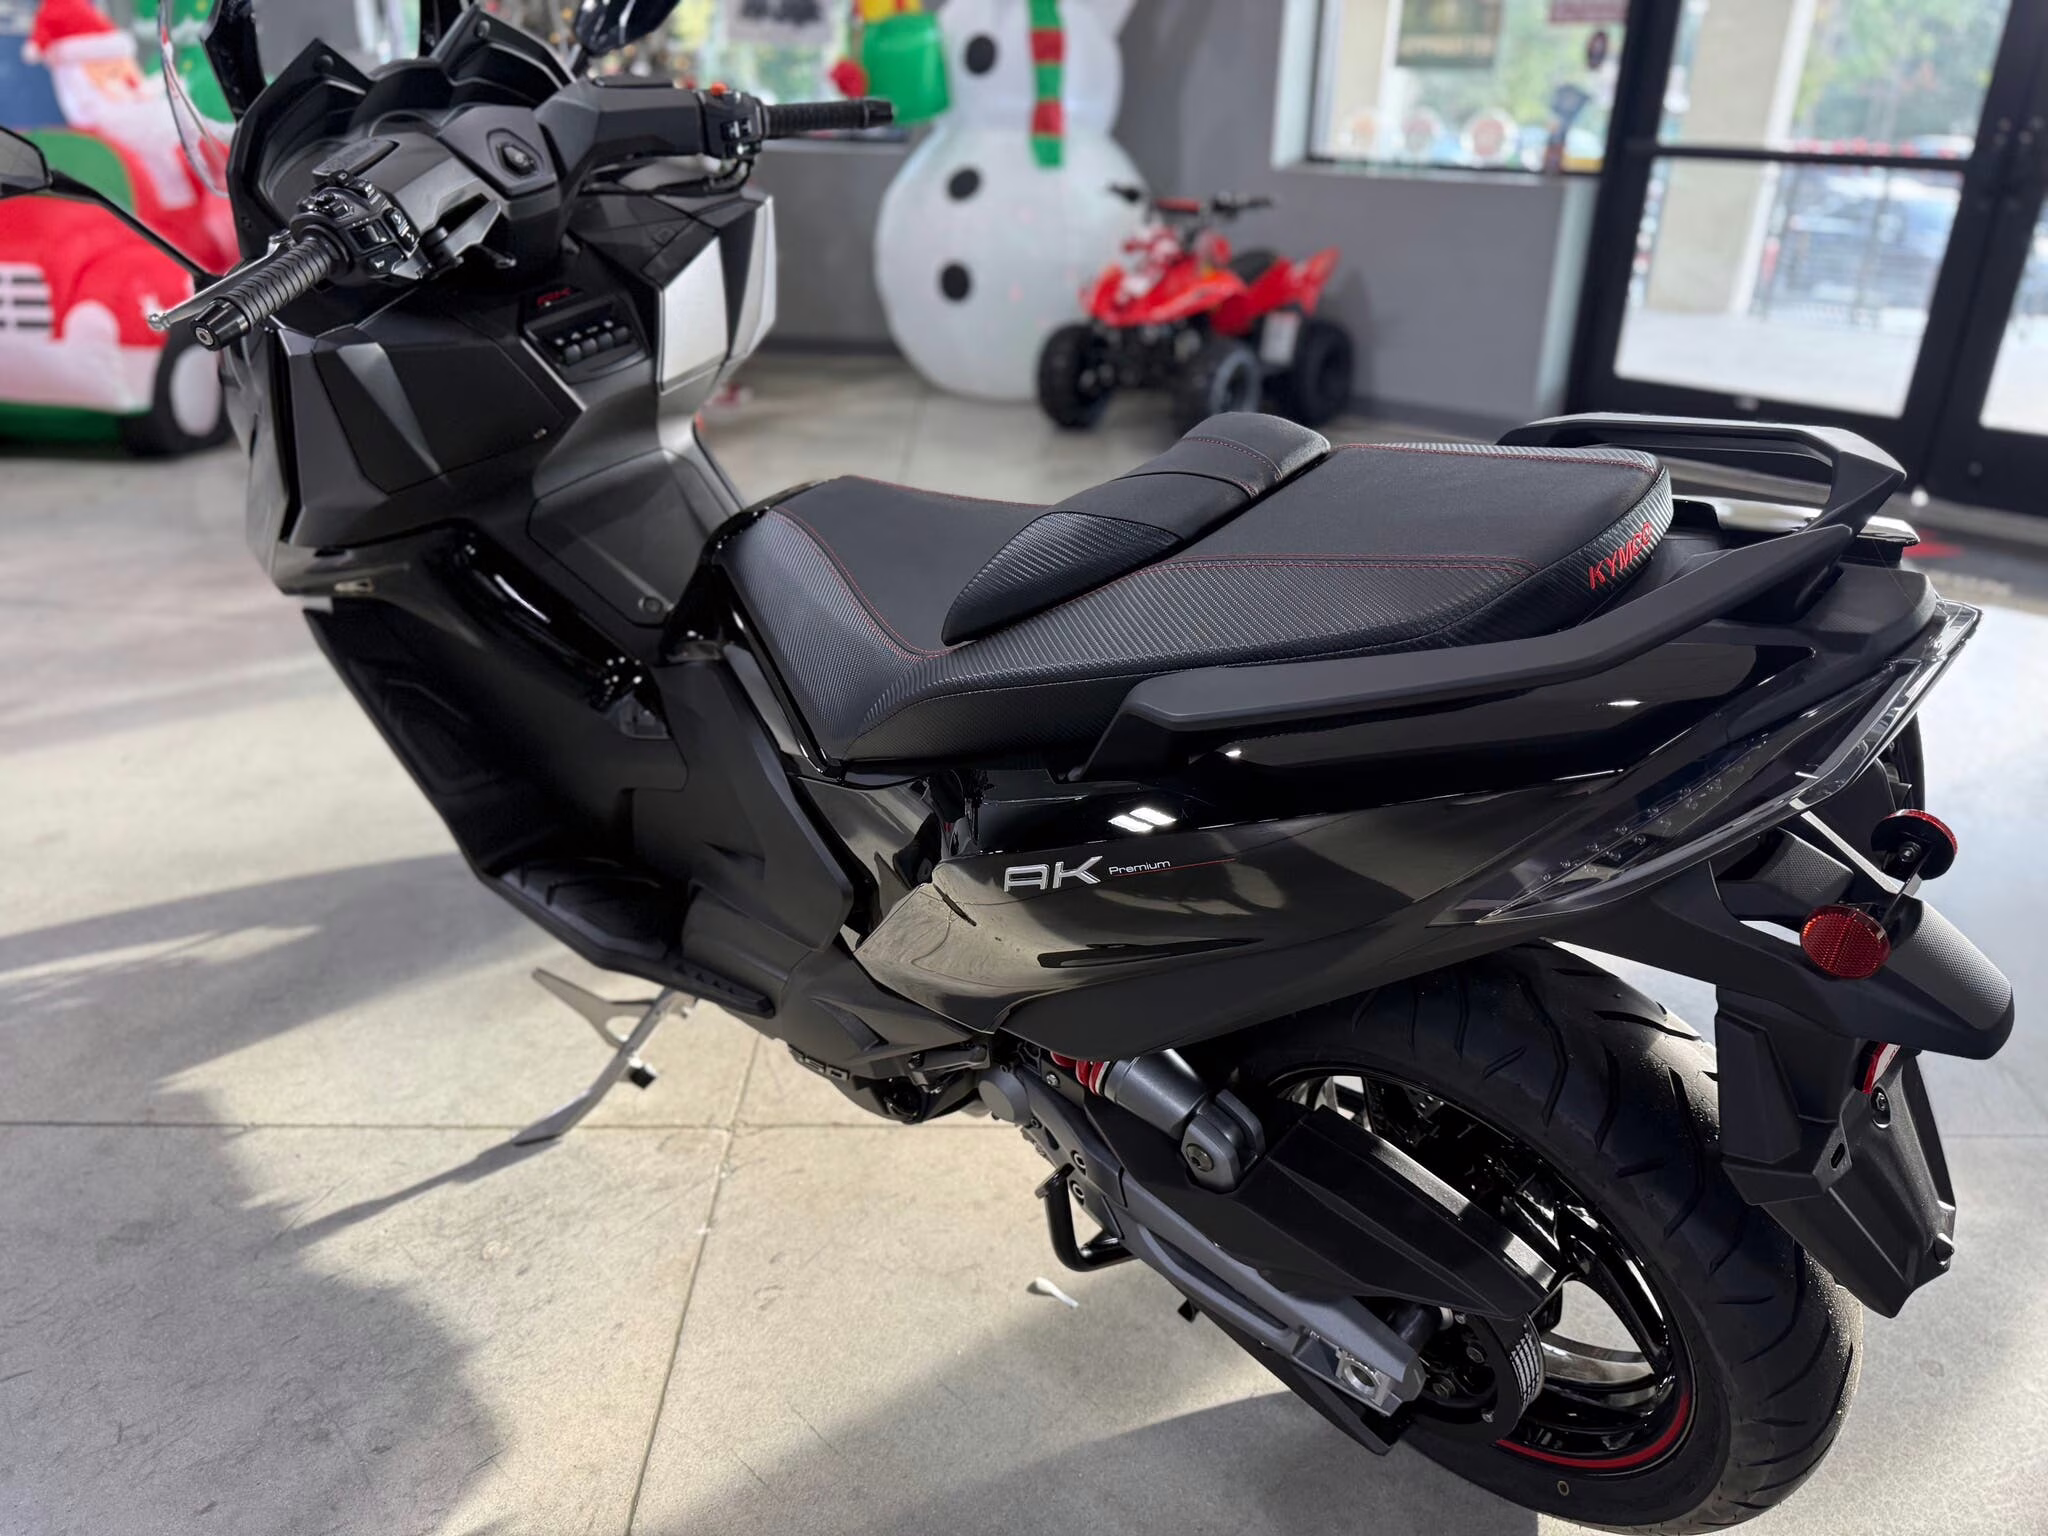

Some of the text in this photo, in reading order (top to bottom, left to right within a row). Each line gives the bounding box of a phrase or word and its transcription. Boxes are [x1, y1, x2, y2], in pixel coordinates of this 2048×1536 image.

[1588, 521, 1652, 590] KYMCO
[1004, 855, 1171, 892] AK Premium
